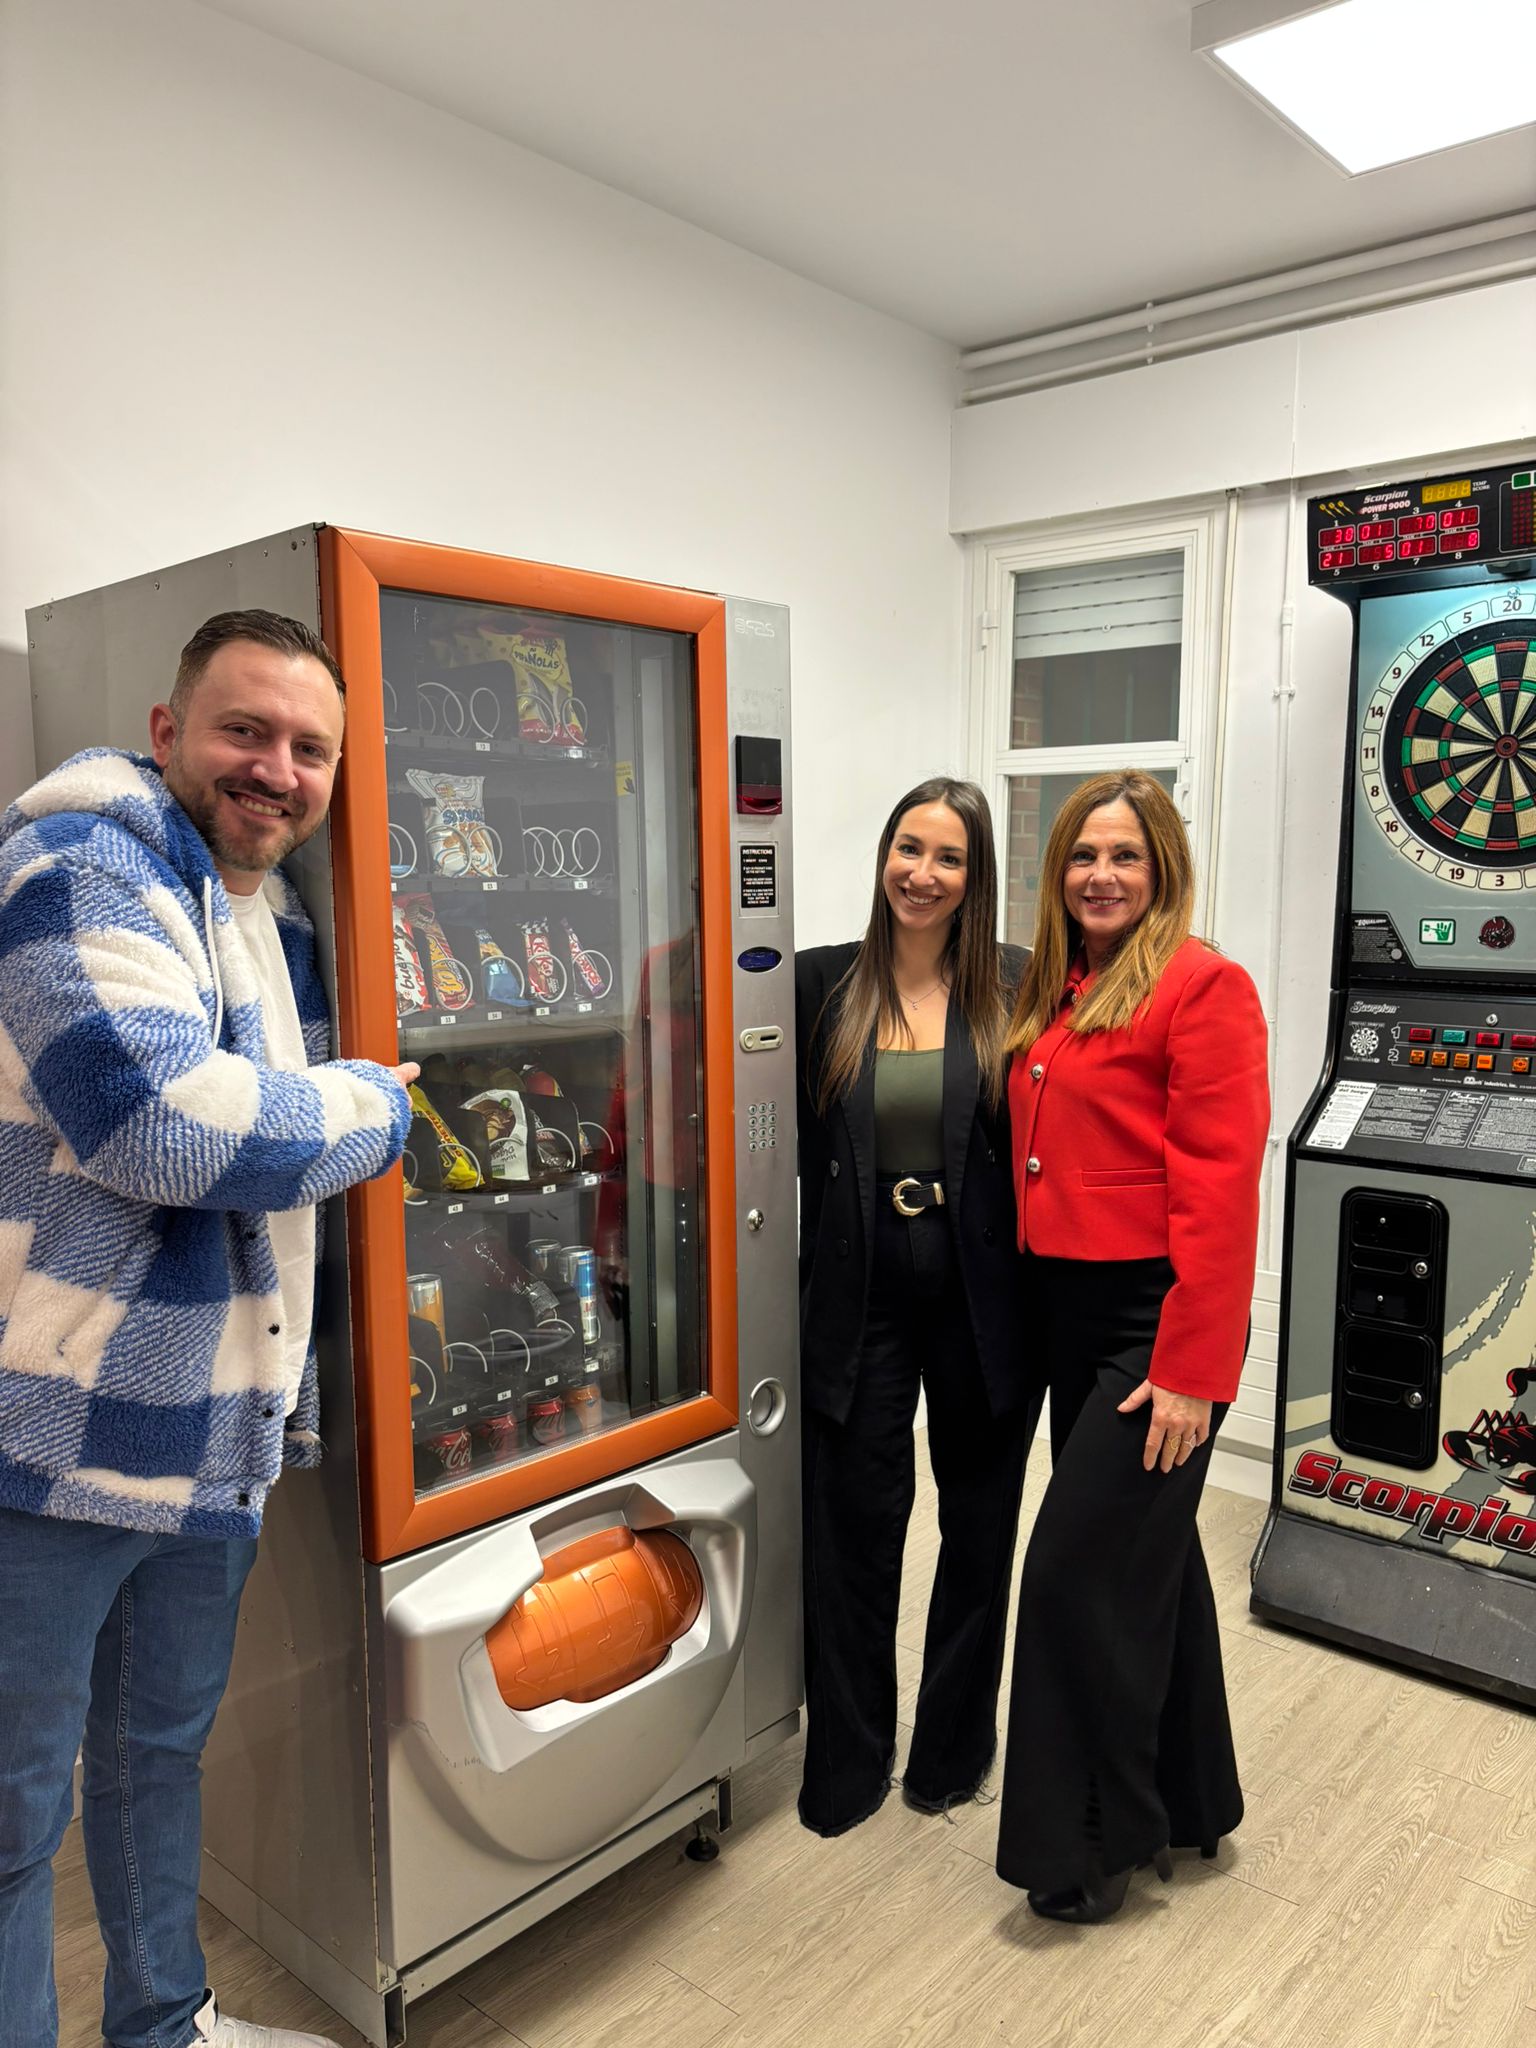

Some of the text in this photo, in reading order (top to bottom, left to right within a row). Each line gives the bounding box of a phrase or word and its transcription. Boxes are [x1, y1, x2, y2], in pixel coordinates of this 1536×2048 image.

[1472, 484, 1490, 492] SCORE
[1363, 490, 1409, 504] Scorpion
[1361, 500, 1411, 515] POWER 9000
[1455, 500, 1462, 508] 4
[1372, 513, 1379, 521] 2
[1413, 507, 1420, 515] 3
[1333, 520, 1338, 528] 1
[1413, 558, 1420, 566] 7
[1455, 552, 1462, 560] 8
[1372, 563, 1380, 571] 6
[1502, 598, 1522, 613] 20
[1462, 611, 1472, 624] 5
[1419, 634, 1435, 647] 12
[1392, 666, 1402, 680] 9
[1369, 706, 1385, 719] 14
[1363, 747, 1376, 760] 11
[1371, 785, 1380, 797] 8
[1384, 820, 1399, 833] 16
[1415, 849, 1425, 862] 7
[1449, 868, 1465, 880] 19
[1495, 874, 1505, 887] 3
[394, 941, 416, 990] bueno
[1350, 1001, 1397, 1014] Scorpion
[1391, 1026, 1400, 1039] 1
[1388, 1048, 1399, 1061] 2
[1288, 1450, 1536, 1556] Scorpio
